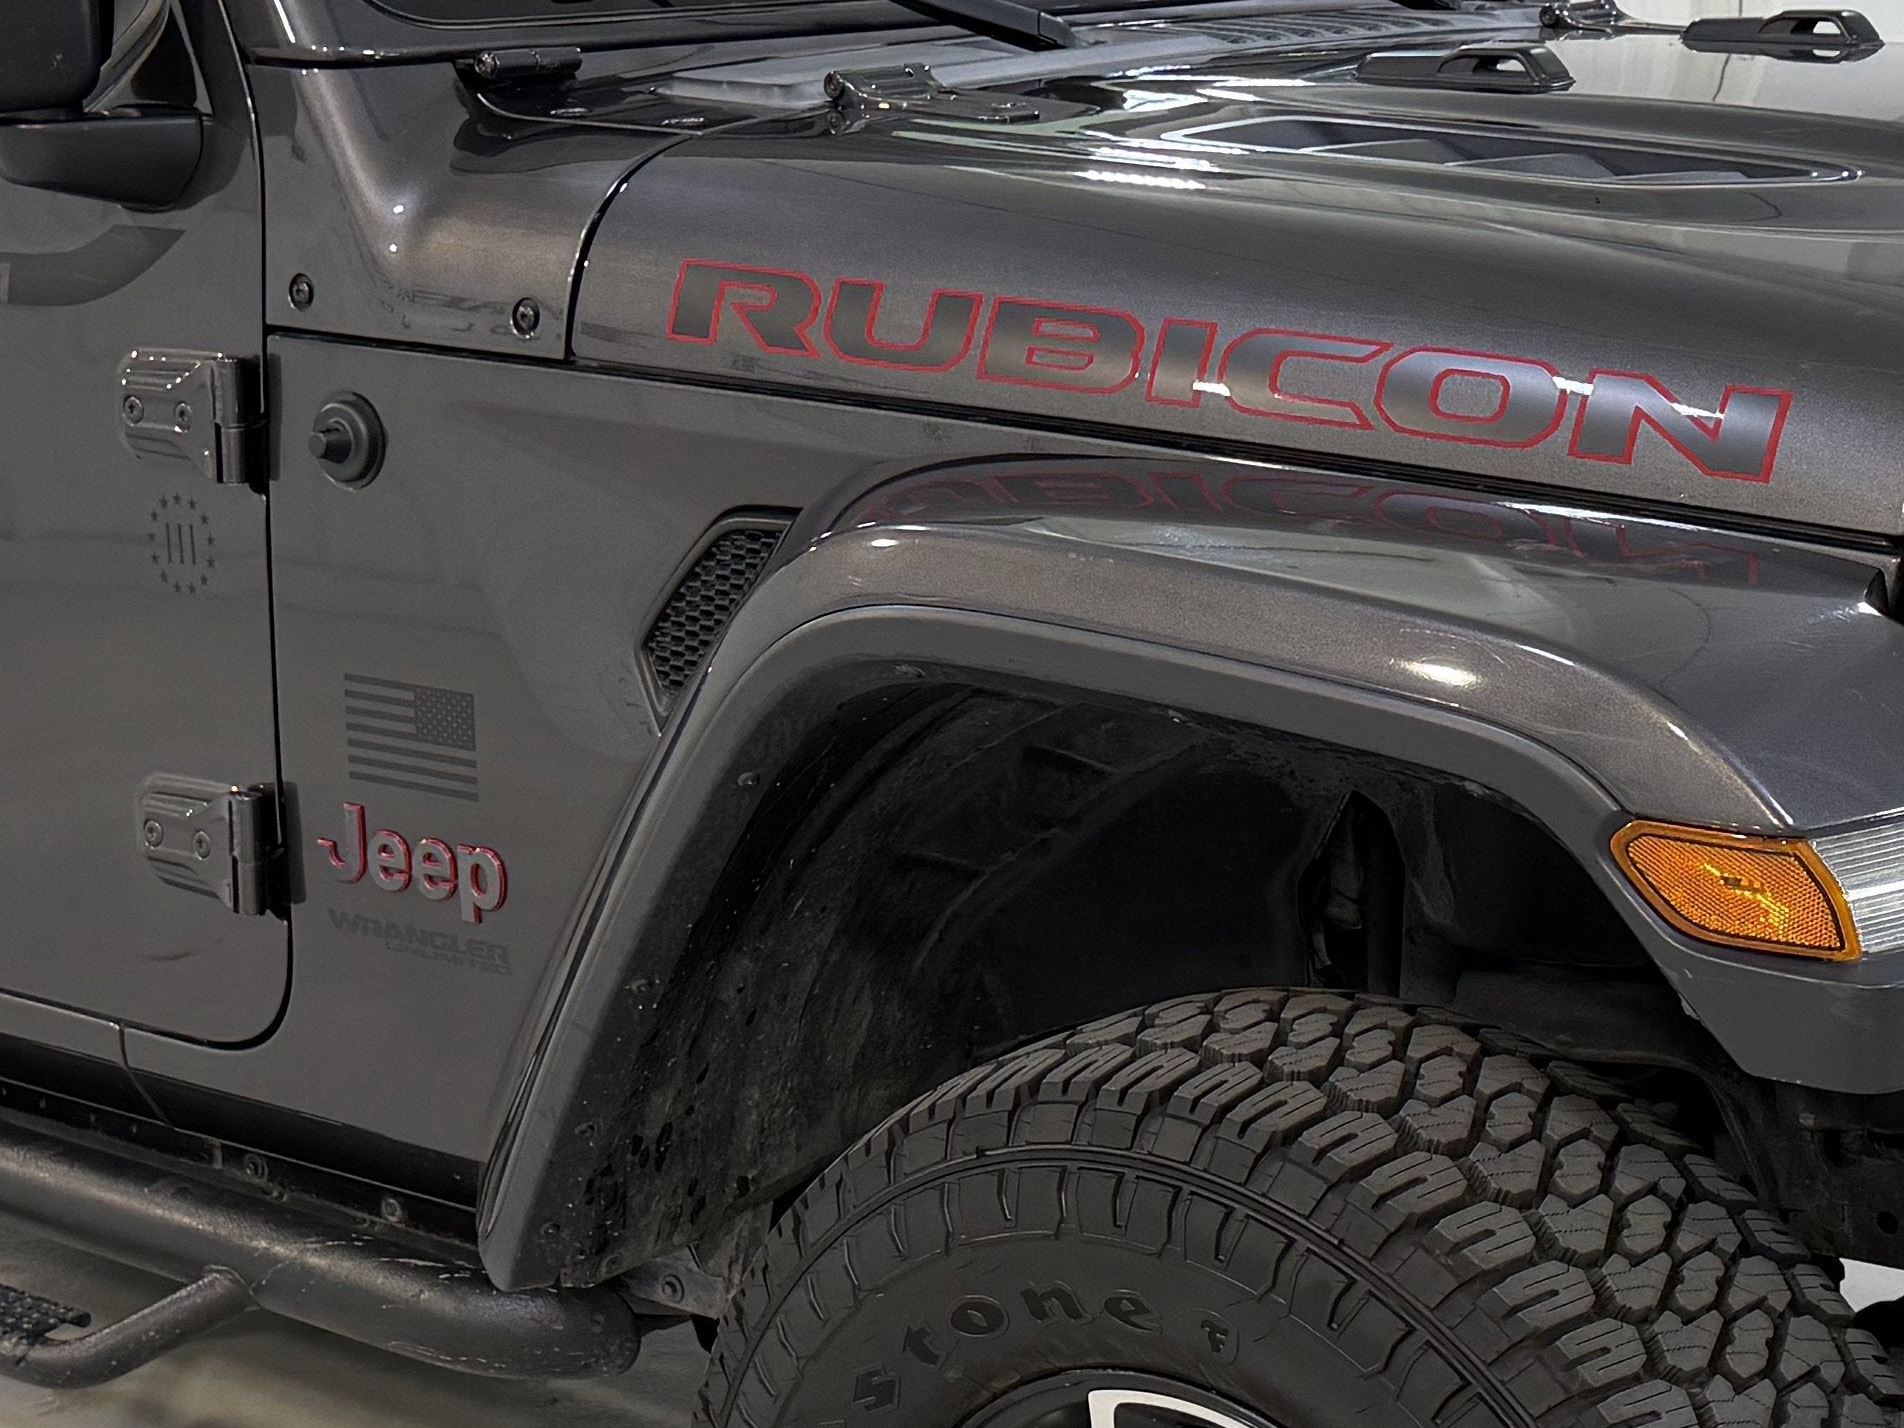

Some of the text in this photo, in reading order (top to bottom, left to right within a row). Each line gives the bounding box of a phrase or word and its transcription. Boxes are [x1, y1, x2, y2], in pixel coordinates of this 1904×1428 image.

[666, 258, 1794, 484] RUBICON
[316, 801, 508, 924] Jeep
[326, 906, 510, 964] WRANGLER
